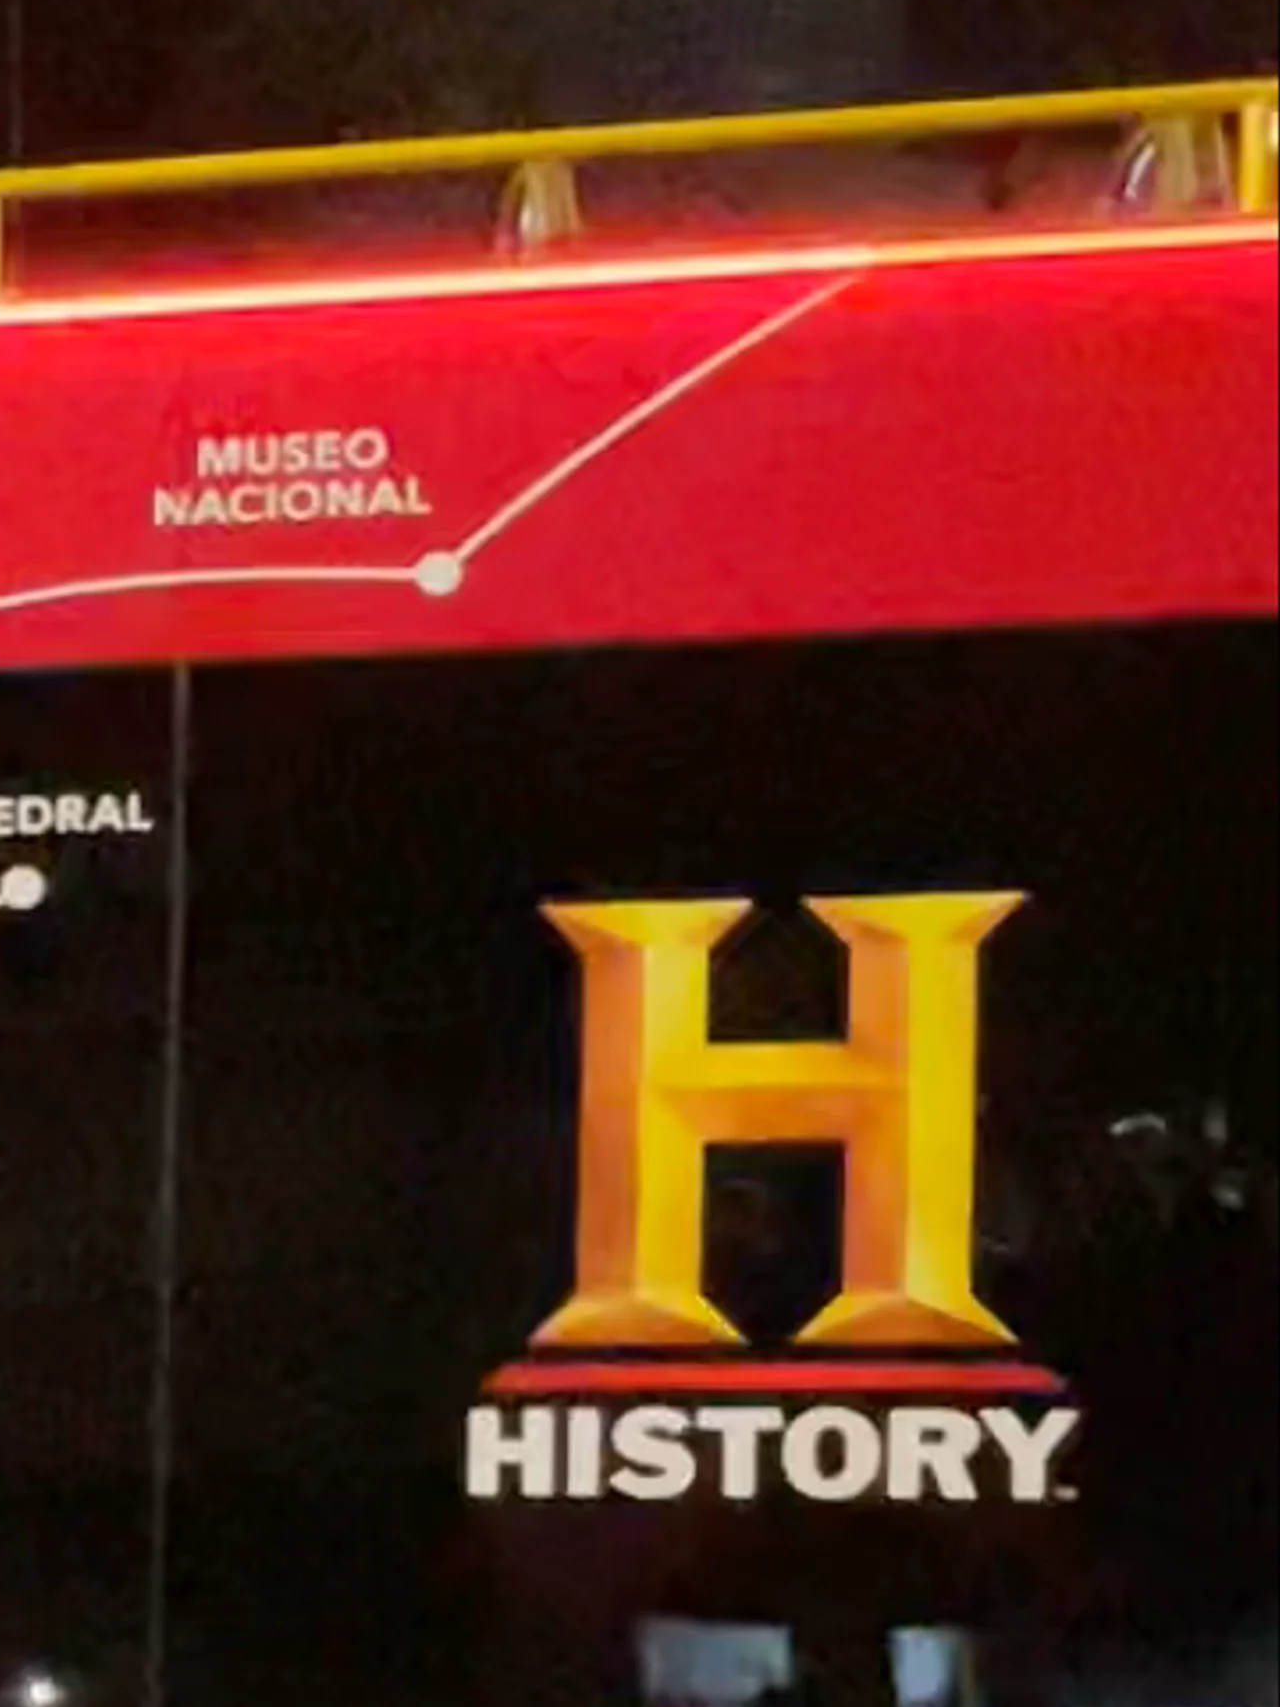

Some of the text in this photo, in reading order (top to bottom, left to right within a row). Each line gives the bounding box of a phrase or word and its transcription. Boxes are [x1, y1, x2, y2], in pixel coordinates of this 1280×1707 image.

[197, 427, 388, 478] MUSEO
[154, 475, 433, 526] NACIONAL
[464, 1405, 1081, 1502] HISTORY
